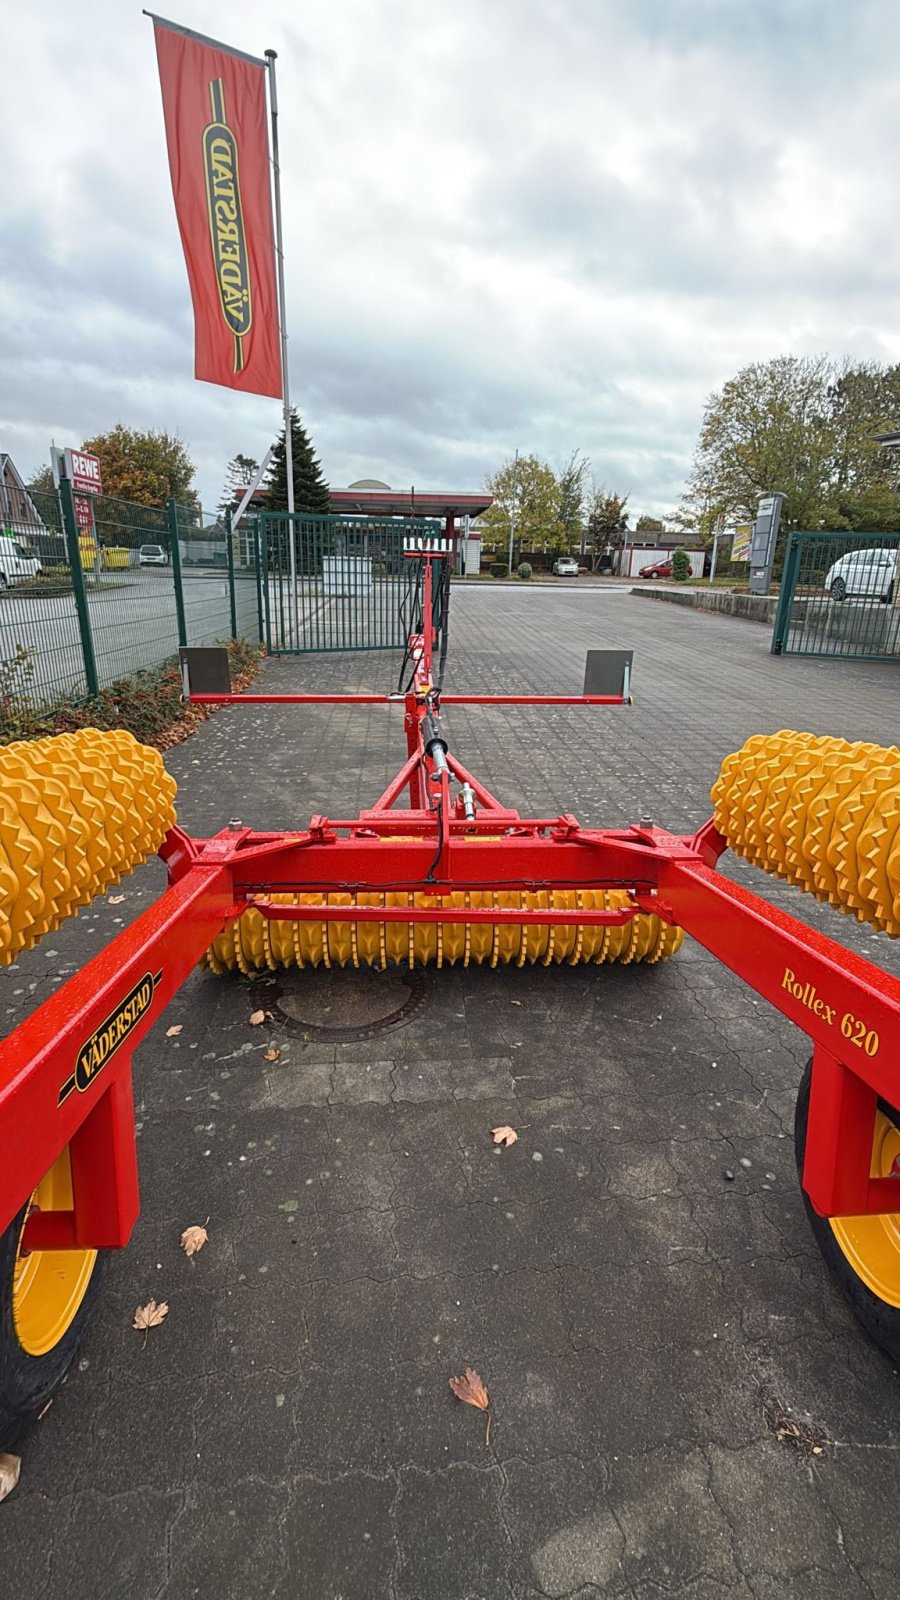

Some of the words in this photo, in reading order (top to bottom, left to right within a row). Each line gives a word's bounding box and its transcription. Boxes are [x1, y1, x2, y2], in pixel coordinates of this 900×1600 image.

[72, 453, 100, 480] REWE
[81, 983, 150, 1078] VÄDERSTAD
[781, 967, 836, 1026] Rollex
[841, 1013, 879, 1056] 620
